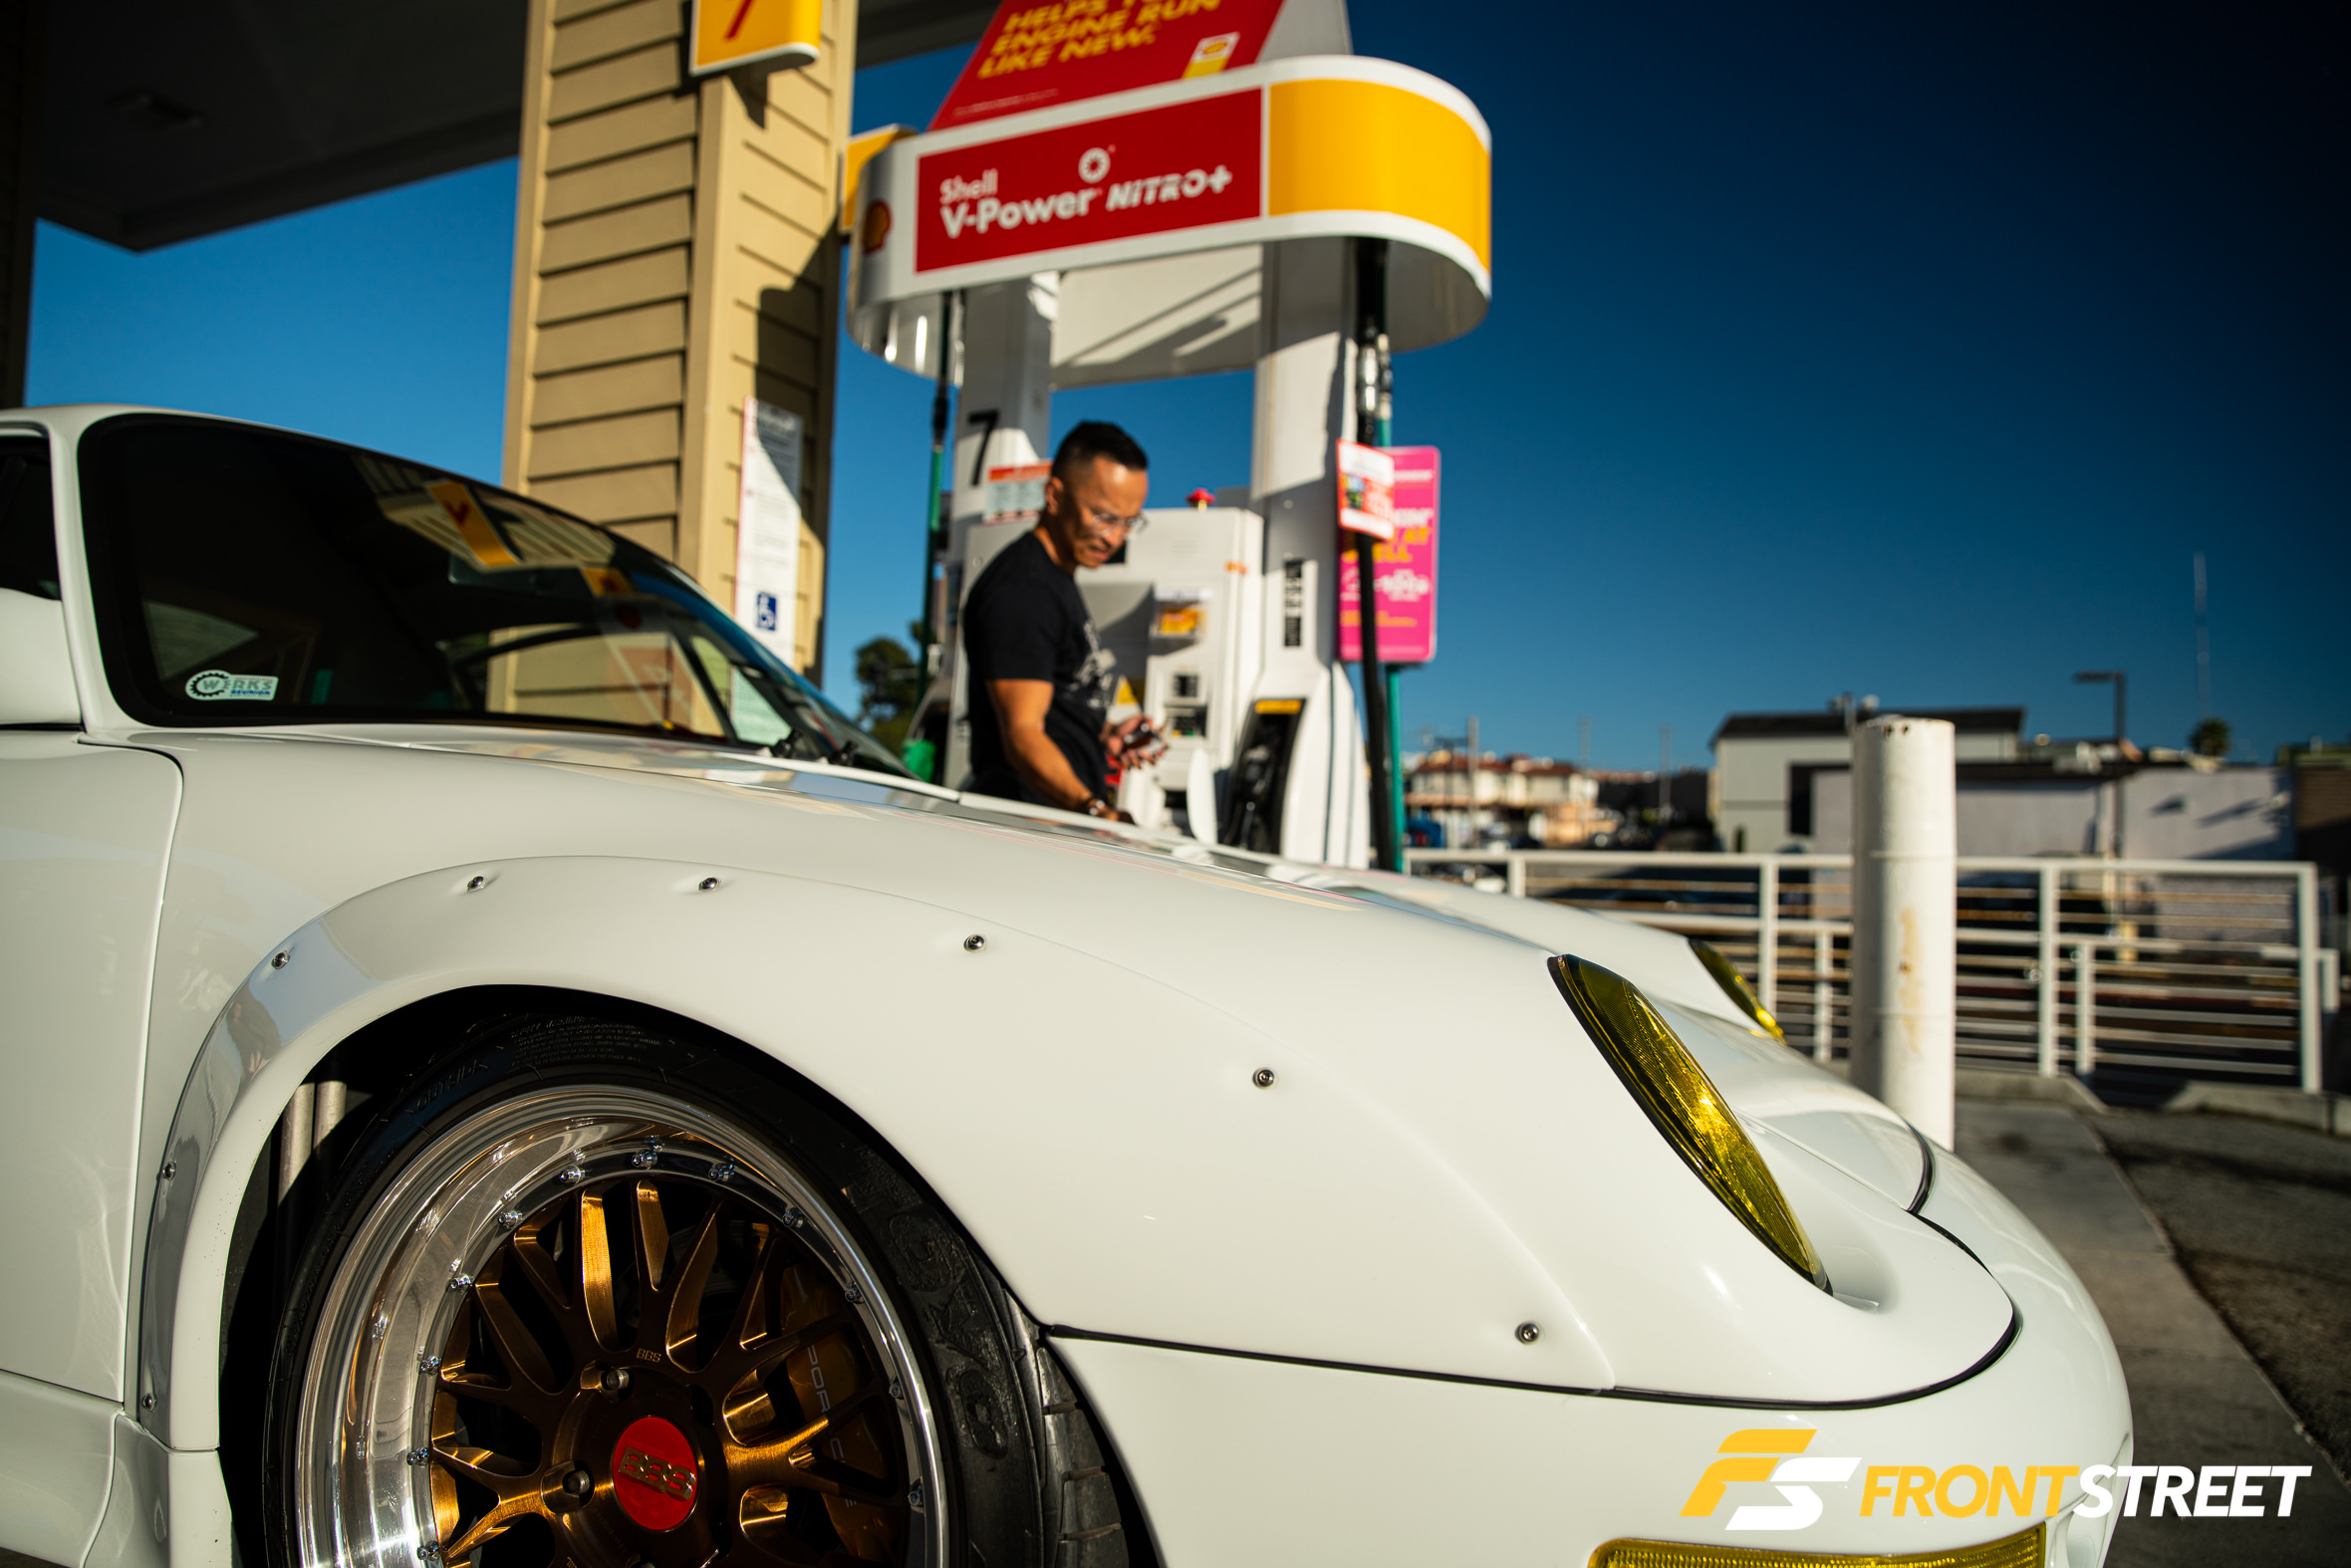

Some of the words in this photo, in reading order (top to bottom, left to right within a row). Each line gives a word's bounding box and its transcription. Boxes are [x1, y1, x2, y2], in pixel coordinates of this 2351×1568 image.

[990, 9, 1131, 55] ENGINE
[1135, 0, 1222, 26] RUN
[977, 45, 1055, 79] LIKE
[939, 167, 999, 204] Shell
[939, 188, 1098, 239] V-Power
[1105, 163, 1233, 211] NITRO+
[968, 408, 1000, 487] 7
[202, 679, 272, 690] WERKS
[635, 1347, 662, 1363] BBS
[618, 1445, 696, 1500] BBS
